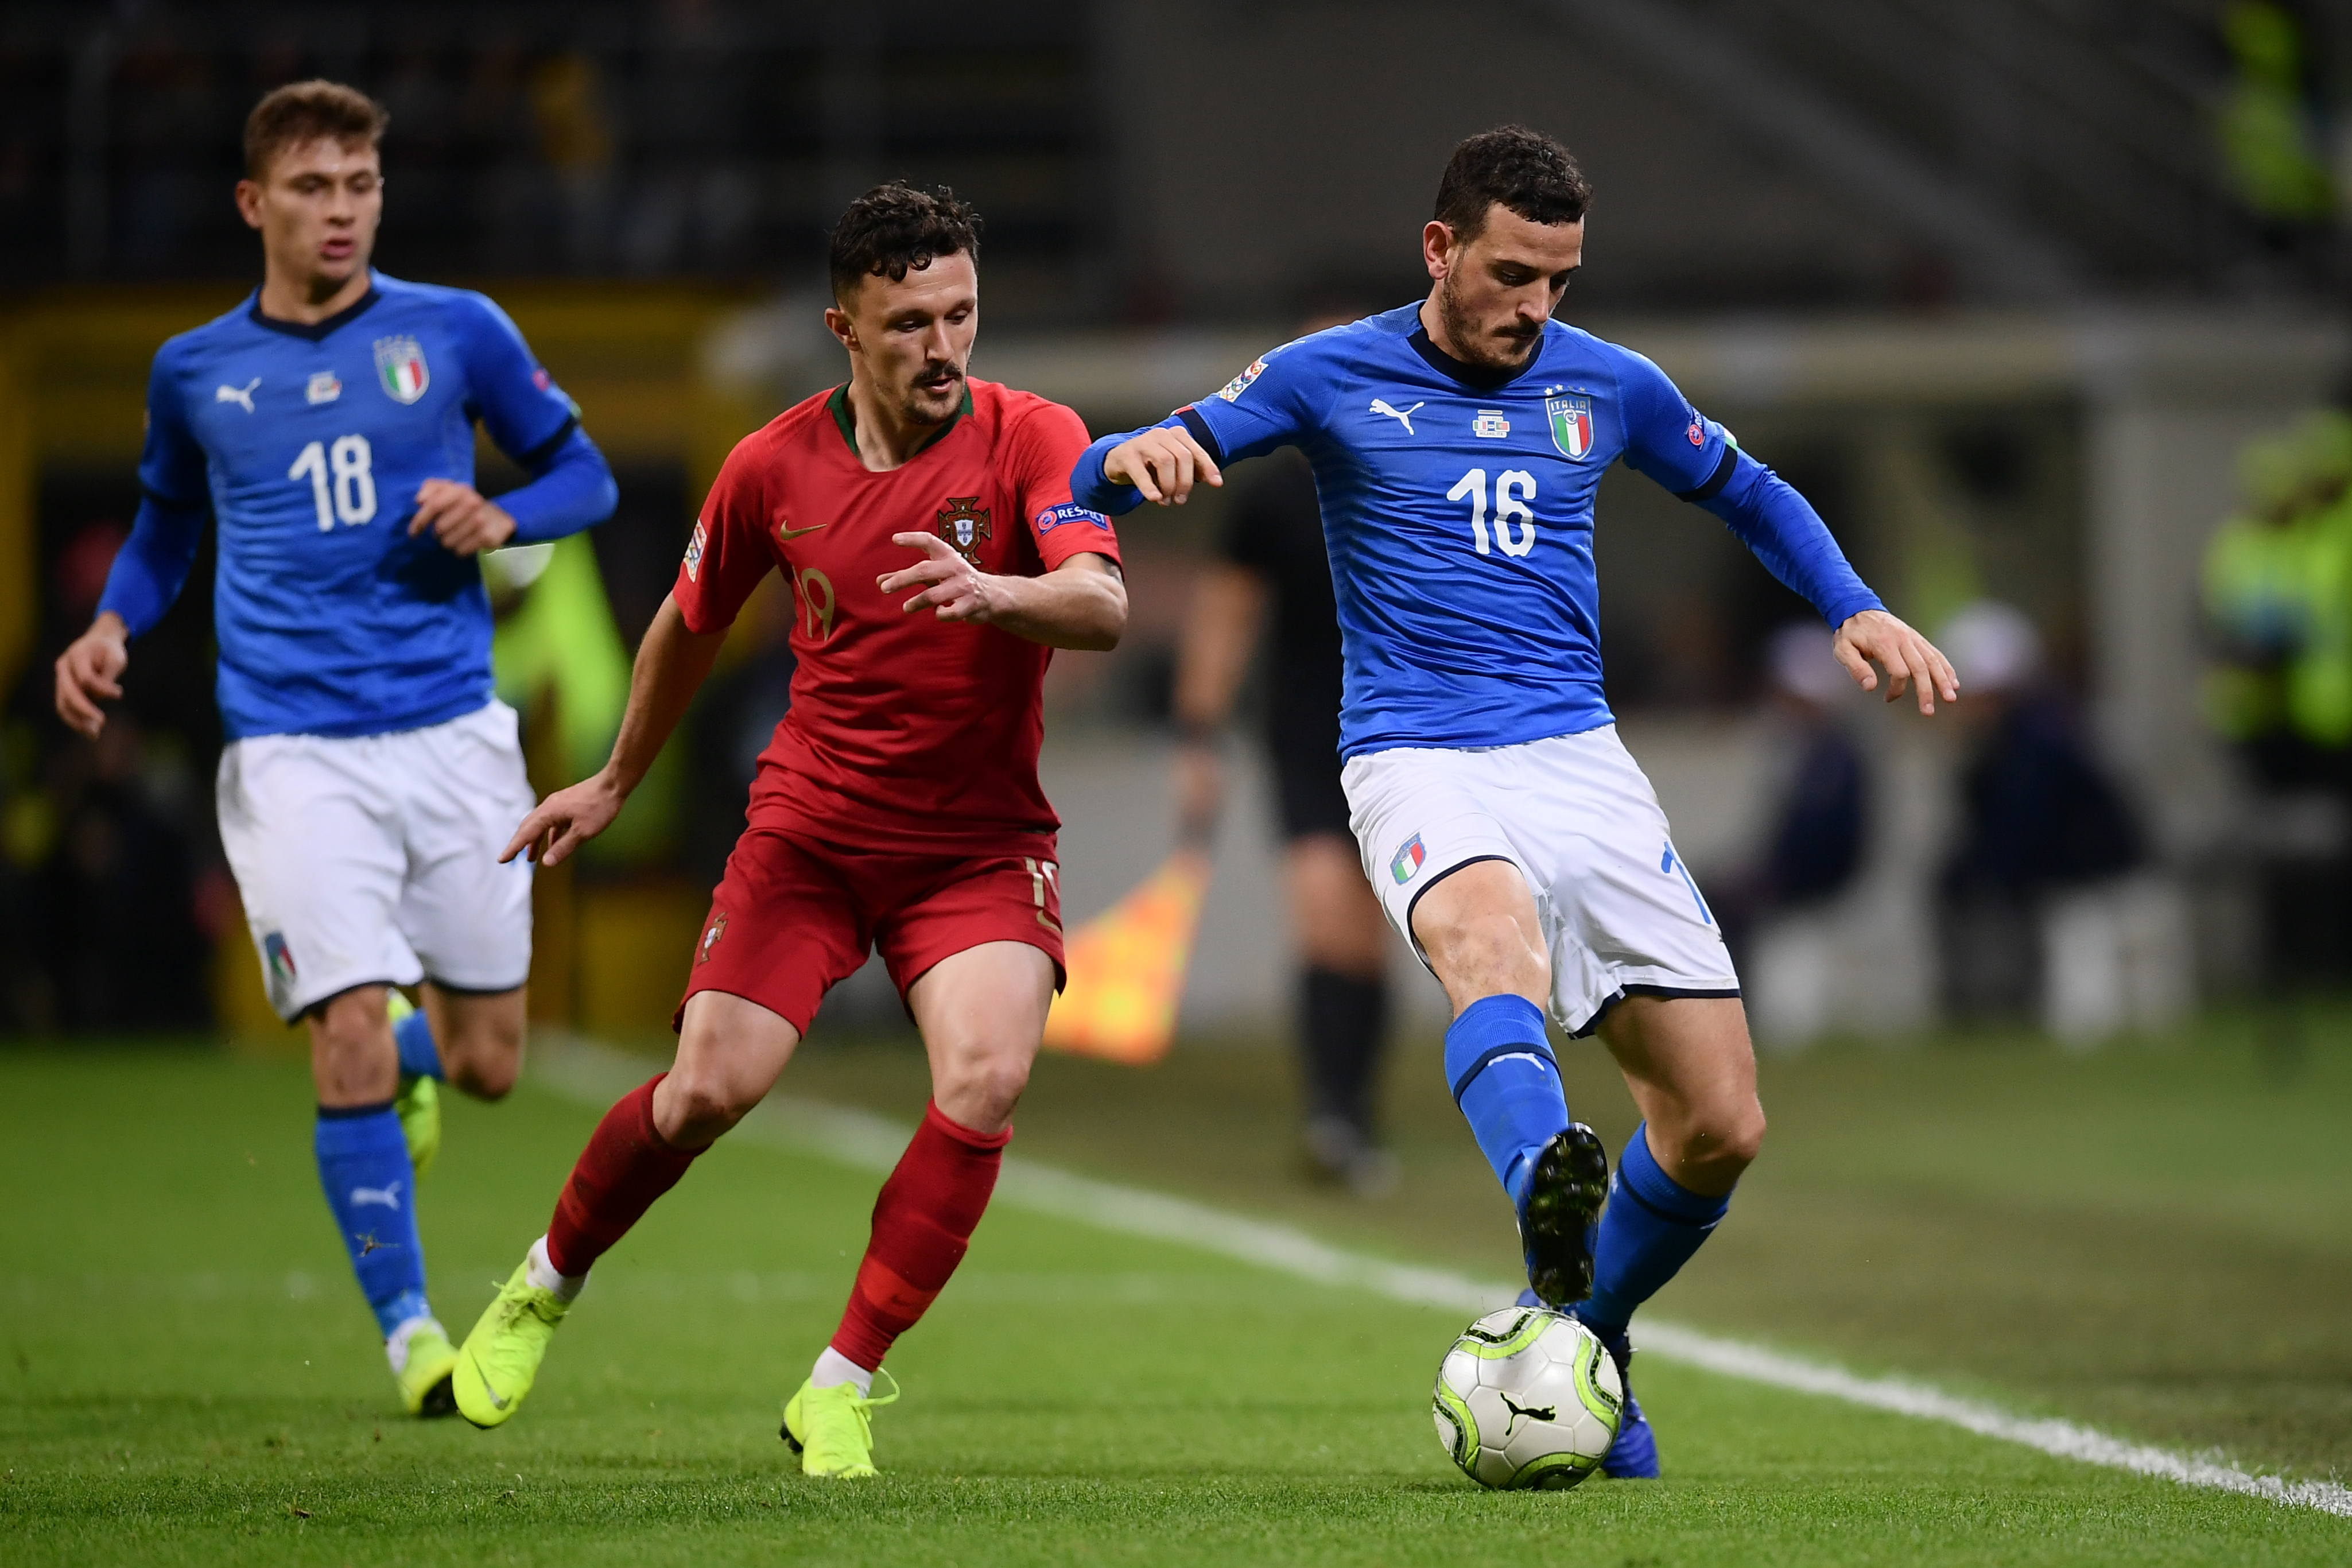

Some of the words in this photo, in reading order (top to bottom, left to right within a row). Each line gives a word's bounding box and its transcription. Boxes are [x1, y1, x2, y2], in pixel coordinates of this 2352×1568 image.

[1550, 399, 1586, 412] ITALIA
[288, 433, 378, 531] 18
[1446, 468, 1536, 557] 16
[792, 564, 835, 642] 19
